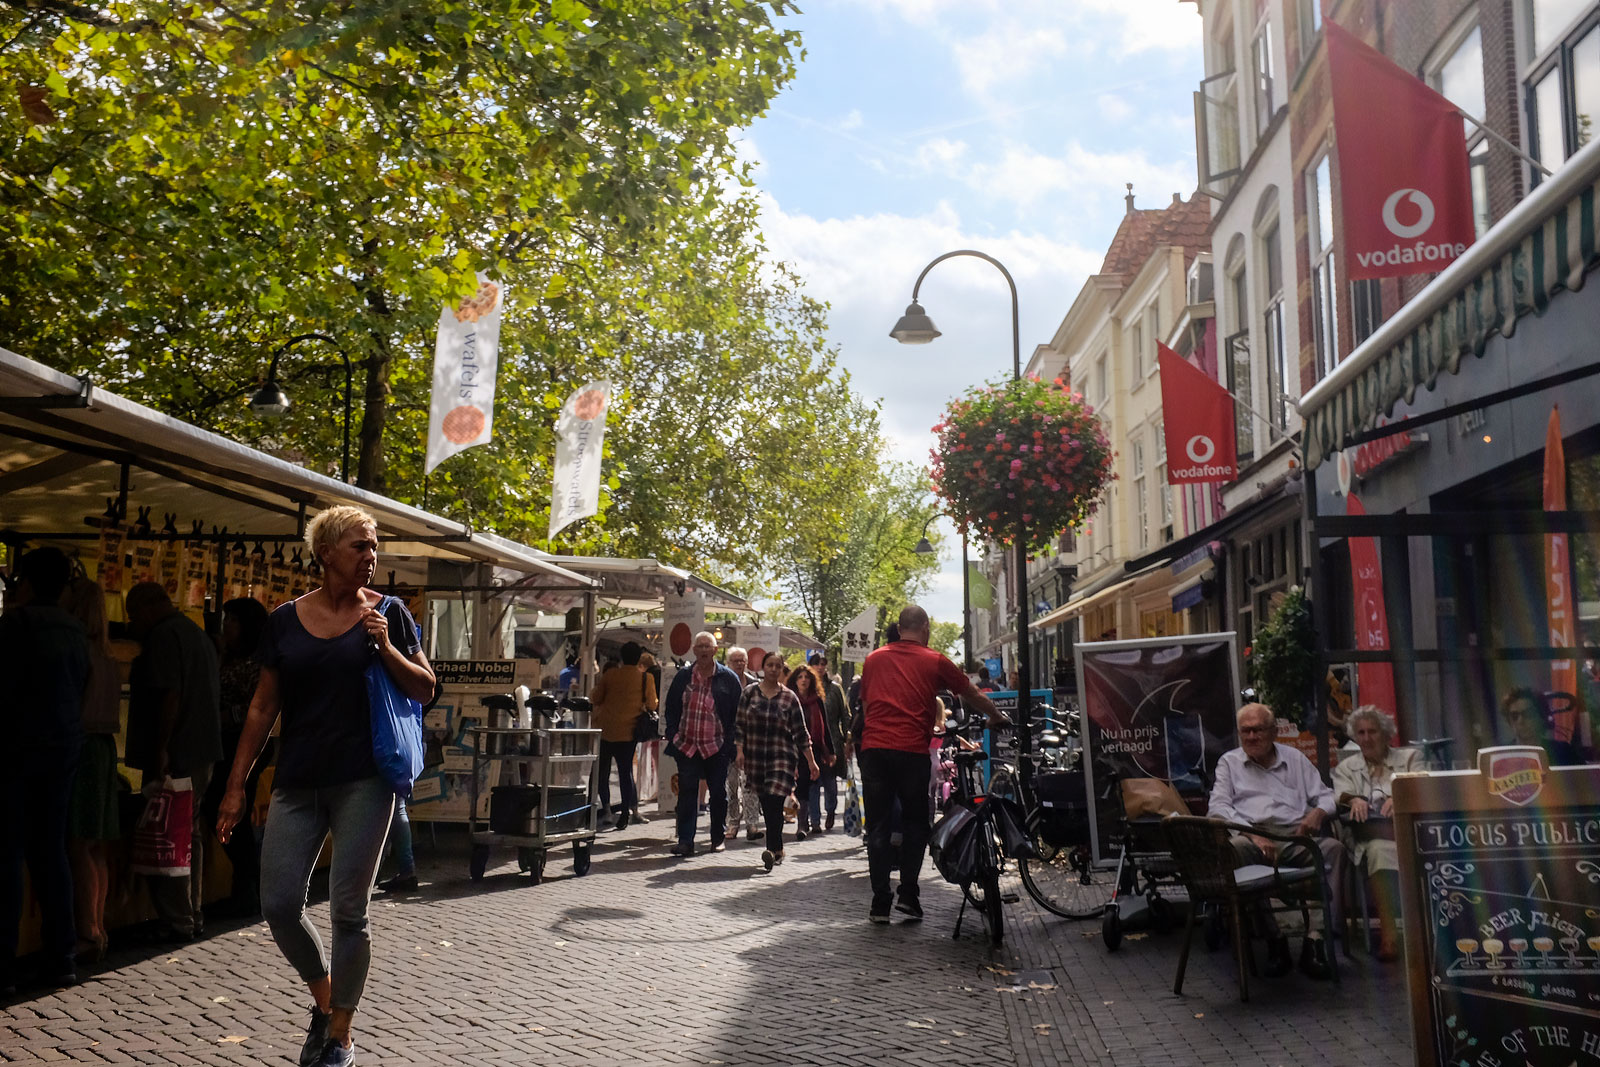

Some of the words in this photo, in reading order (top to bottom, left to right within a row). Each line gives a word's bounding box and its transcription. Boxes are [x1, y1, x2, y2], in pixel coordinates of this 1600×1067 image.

[1356, 241, 1466, 268] vodafone
[460, 332, 480, 400] wafels
[1172, 464, 1232, 479] vodafone
[432, 662, 471, 673] ichael
[475, 662, 514, 673] Nobel
[458, 675, 482, 683] Zilver
[484, 675, 513, 684] Atelier
[1101, 728, 1118, 740] Nu
[1121, 728, 1132, 739] in
[1135, 725, 1160, 741] prijs
[1101, 740, 1153, 755] verlaagd
[1429, 823, 1507, 848] LOCUS
[1512, 821, 1600, 845] PUbLiC
[1479, 907, 1526, 938] BEER
[1501, 1028, 1528, 1054] OF
[1528, 1026, 1571, 1048] THE
